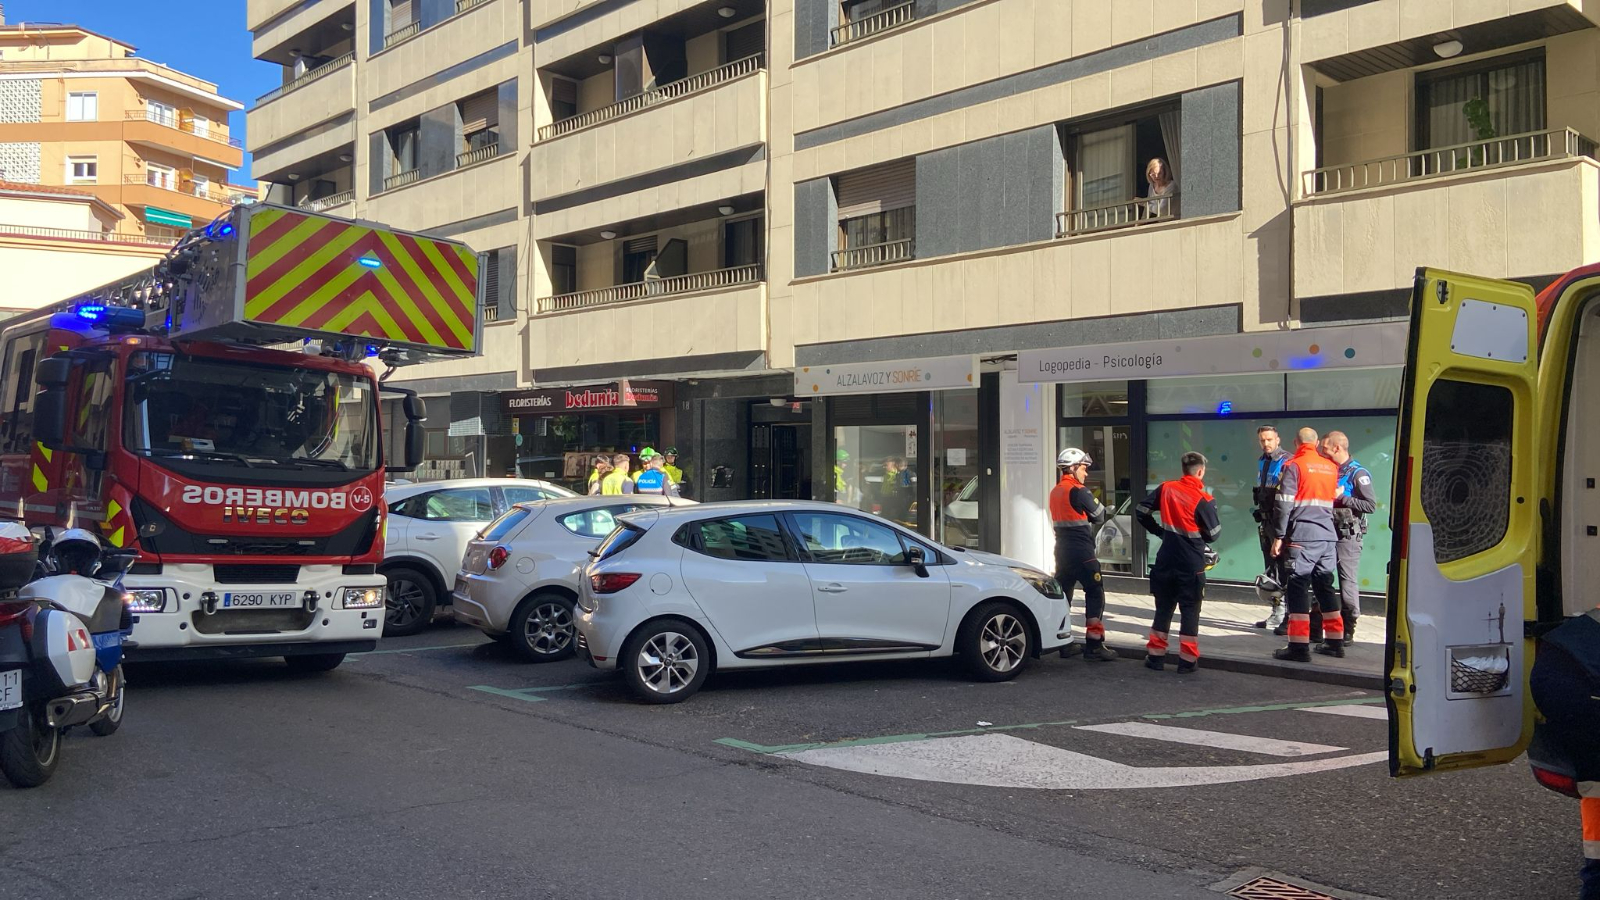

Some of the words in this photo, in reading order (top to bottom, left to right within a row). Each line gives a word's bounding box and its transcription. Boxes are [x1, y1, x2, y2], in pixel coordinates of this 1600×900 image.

[1039, 358, 1091, 375] Logopedia
[1103, 352, 1163, 369] Psicología
[509, 394, 552, 408] FLORISTERÍAS
[353, 494, 370, 504] V-5
[223, 506, 309, 525] IVECO
[232, 594, 263, 606] 6290
[269, 593, 292, 606] KYP
